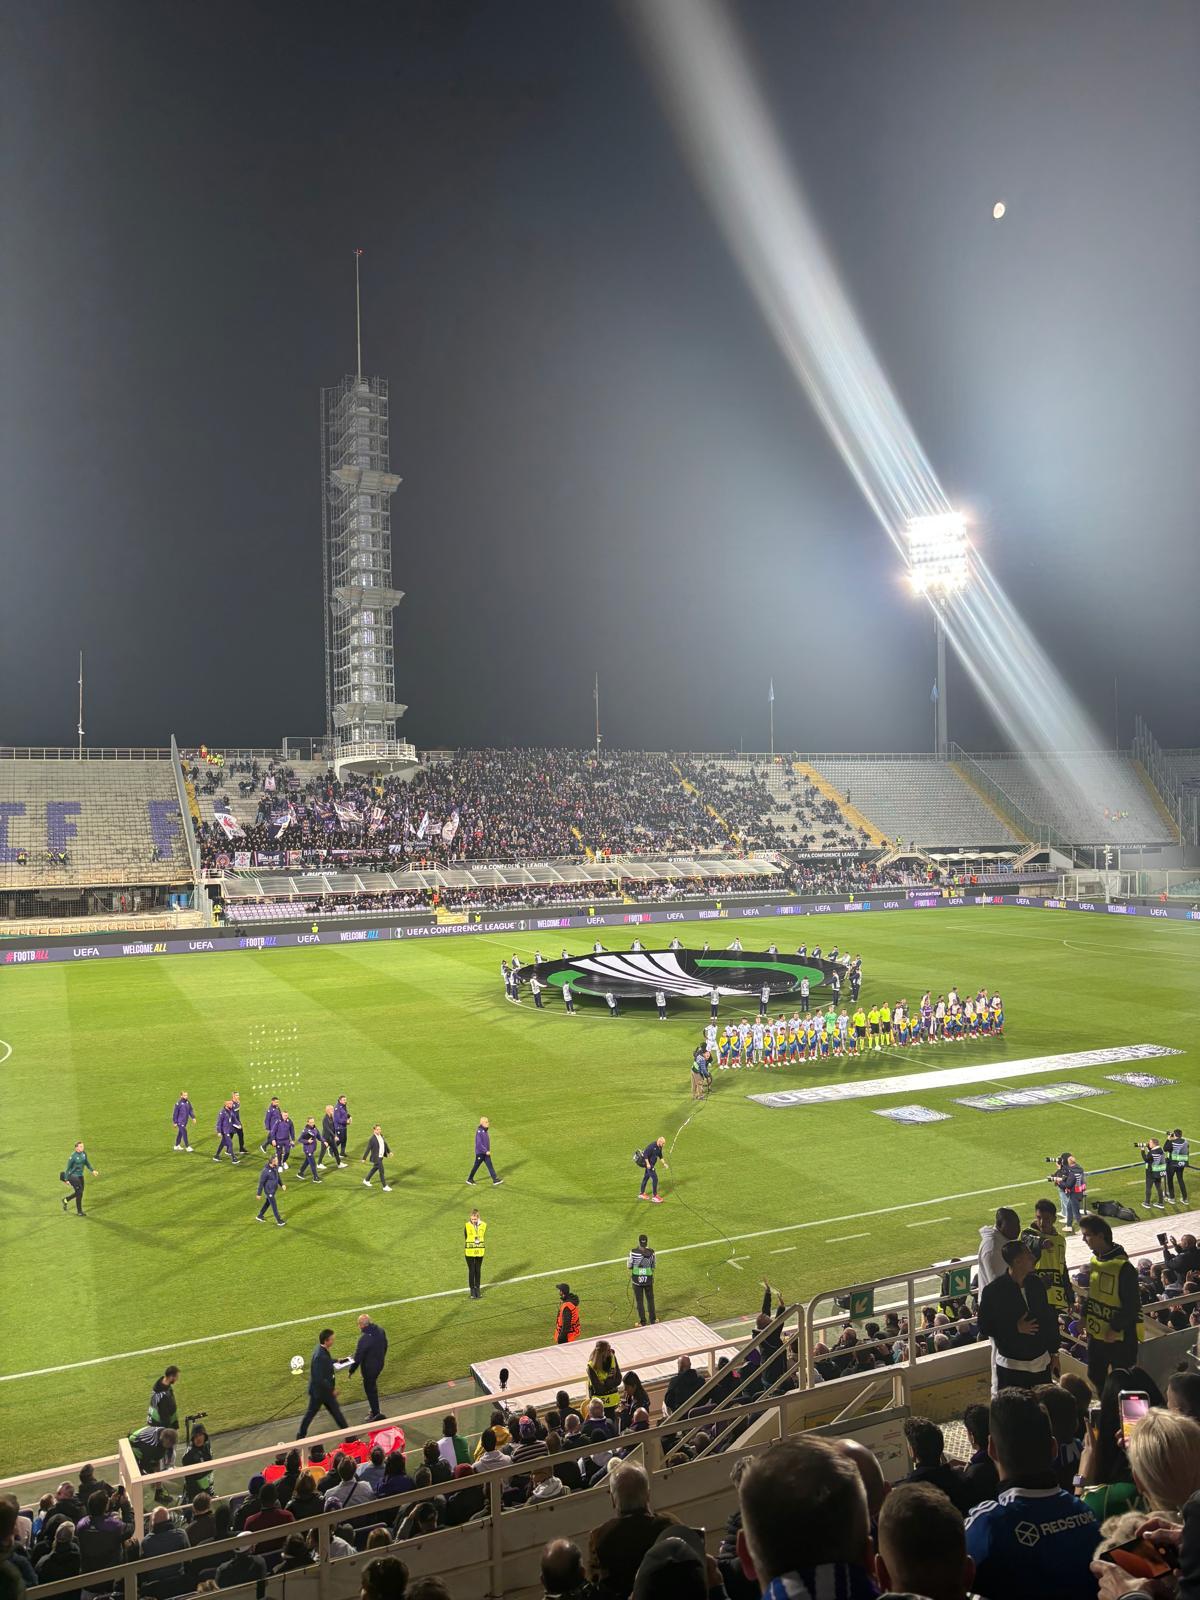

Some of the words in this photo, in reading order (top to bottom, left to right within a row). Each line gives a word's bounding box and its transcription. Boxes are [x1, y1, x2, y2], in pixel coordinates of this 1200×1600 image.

[667, 912, 684, 920] UEFA
[1150, 909, 1168, 917] UEFA
[586, 917, 605, 925] UEFA
[407, 928, 429, 936] UEFA
[430, 923, 483, 934] CONFERENCE
[485, 922, 515, 931] LEAGUE
[297, 934, 320, 943] UEFA
[189, 941, 214, 950] UEFA
[73, 947, 100, 957] UEFA
